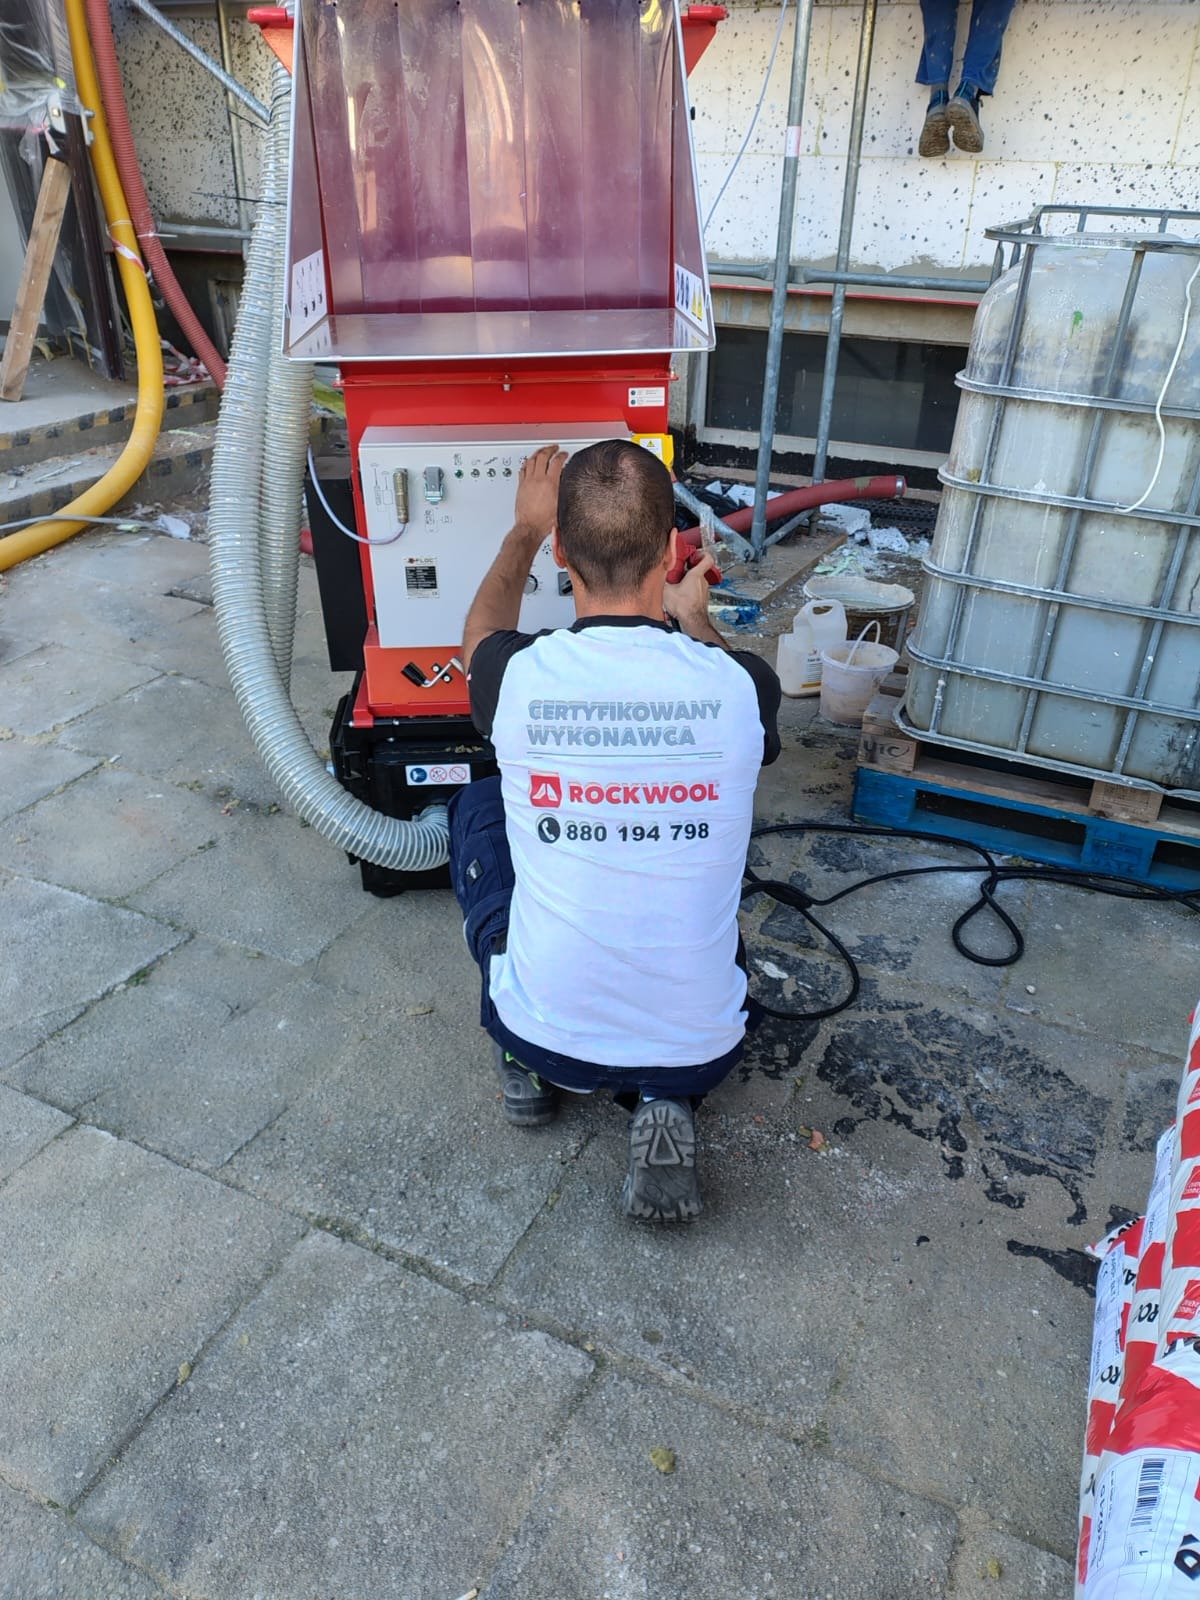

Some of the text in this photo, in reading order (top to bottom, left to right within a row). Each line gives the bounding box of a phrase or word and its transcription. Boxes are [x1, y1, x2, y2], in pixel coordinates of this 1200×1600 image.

[528, 699, 722, 721] CERTYFIKOWANY
[527, 724, 696, 747] WYKONAWCA
[569, 782, 720, 804] ROCKWOOL
[565, 821, 709, 842] 880 194 798
